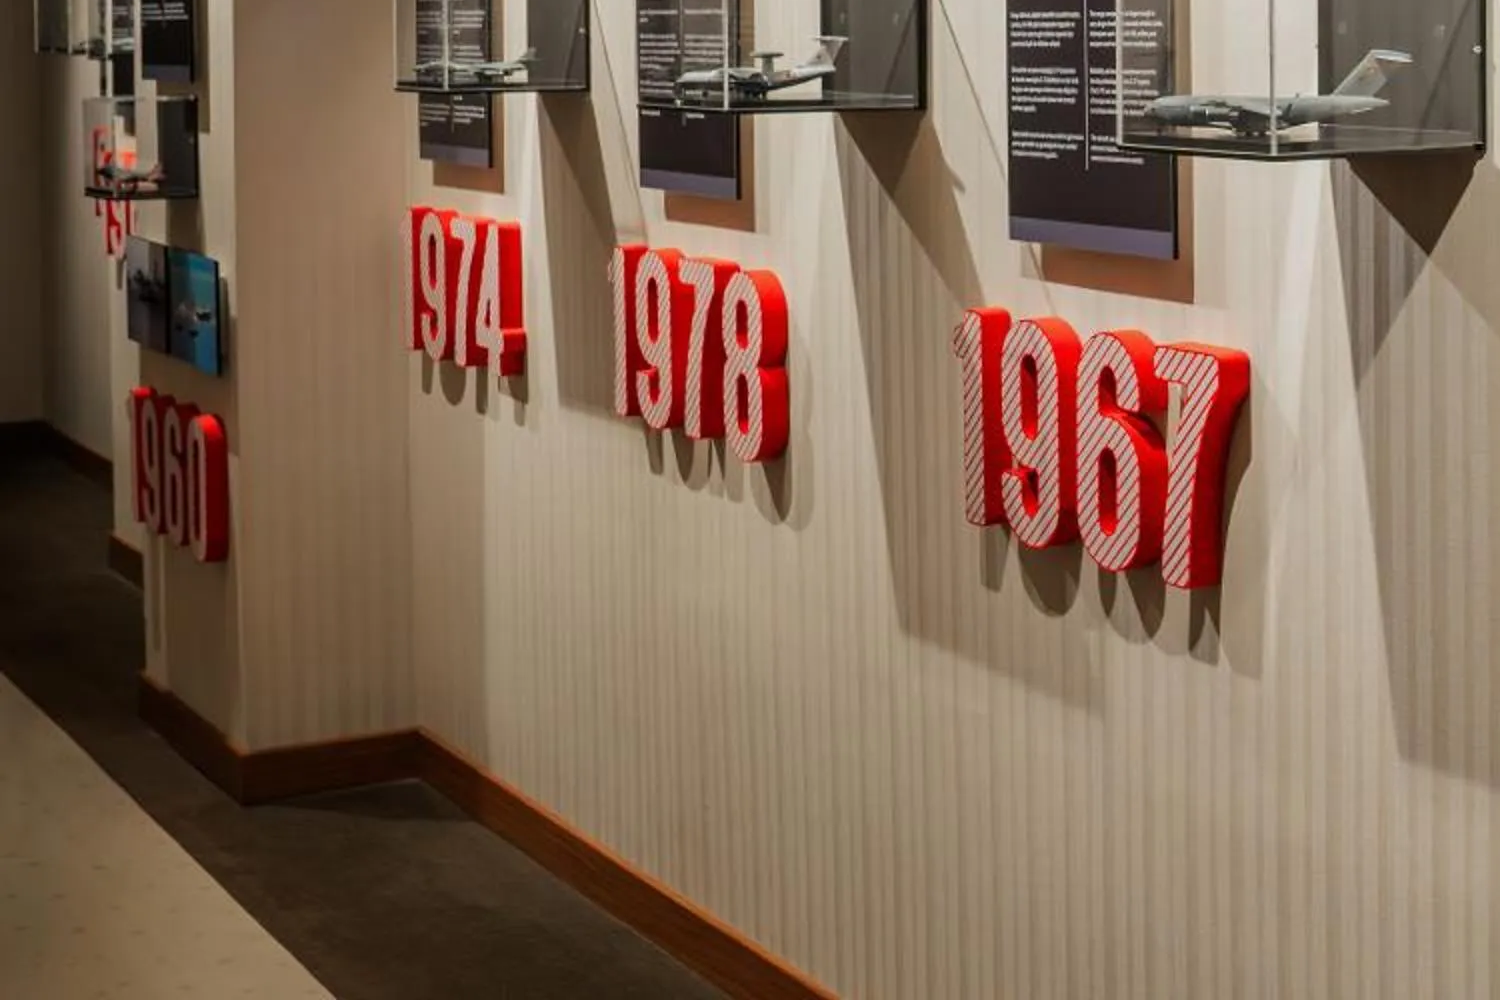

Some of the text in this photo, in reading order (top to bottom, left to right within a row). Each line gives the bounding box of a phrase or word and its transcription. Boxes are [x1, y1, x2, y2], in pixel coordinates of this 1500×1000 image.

[401, 206, 527, 376] 1974
[609, 243, 790, 462] 1978
[130, 387, 229, 562] 1960
[953, 307, 1250, 589] 1967
